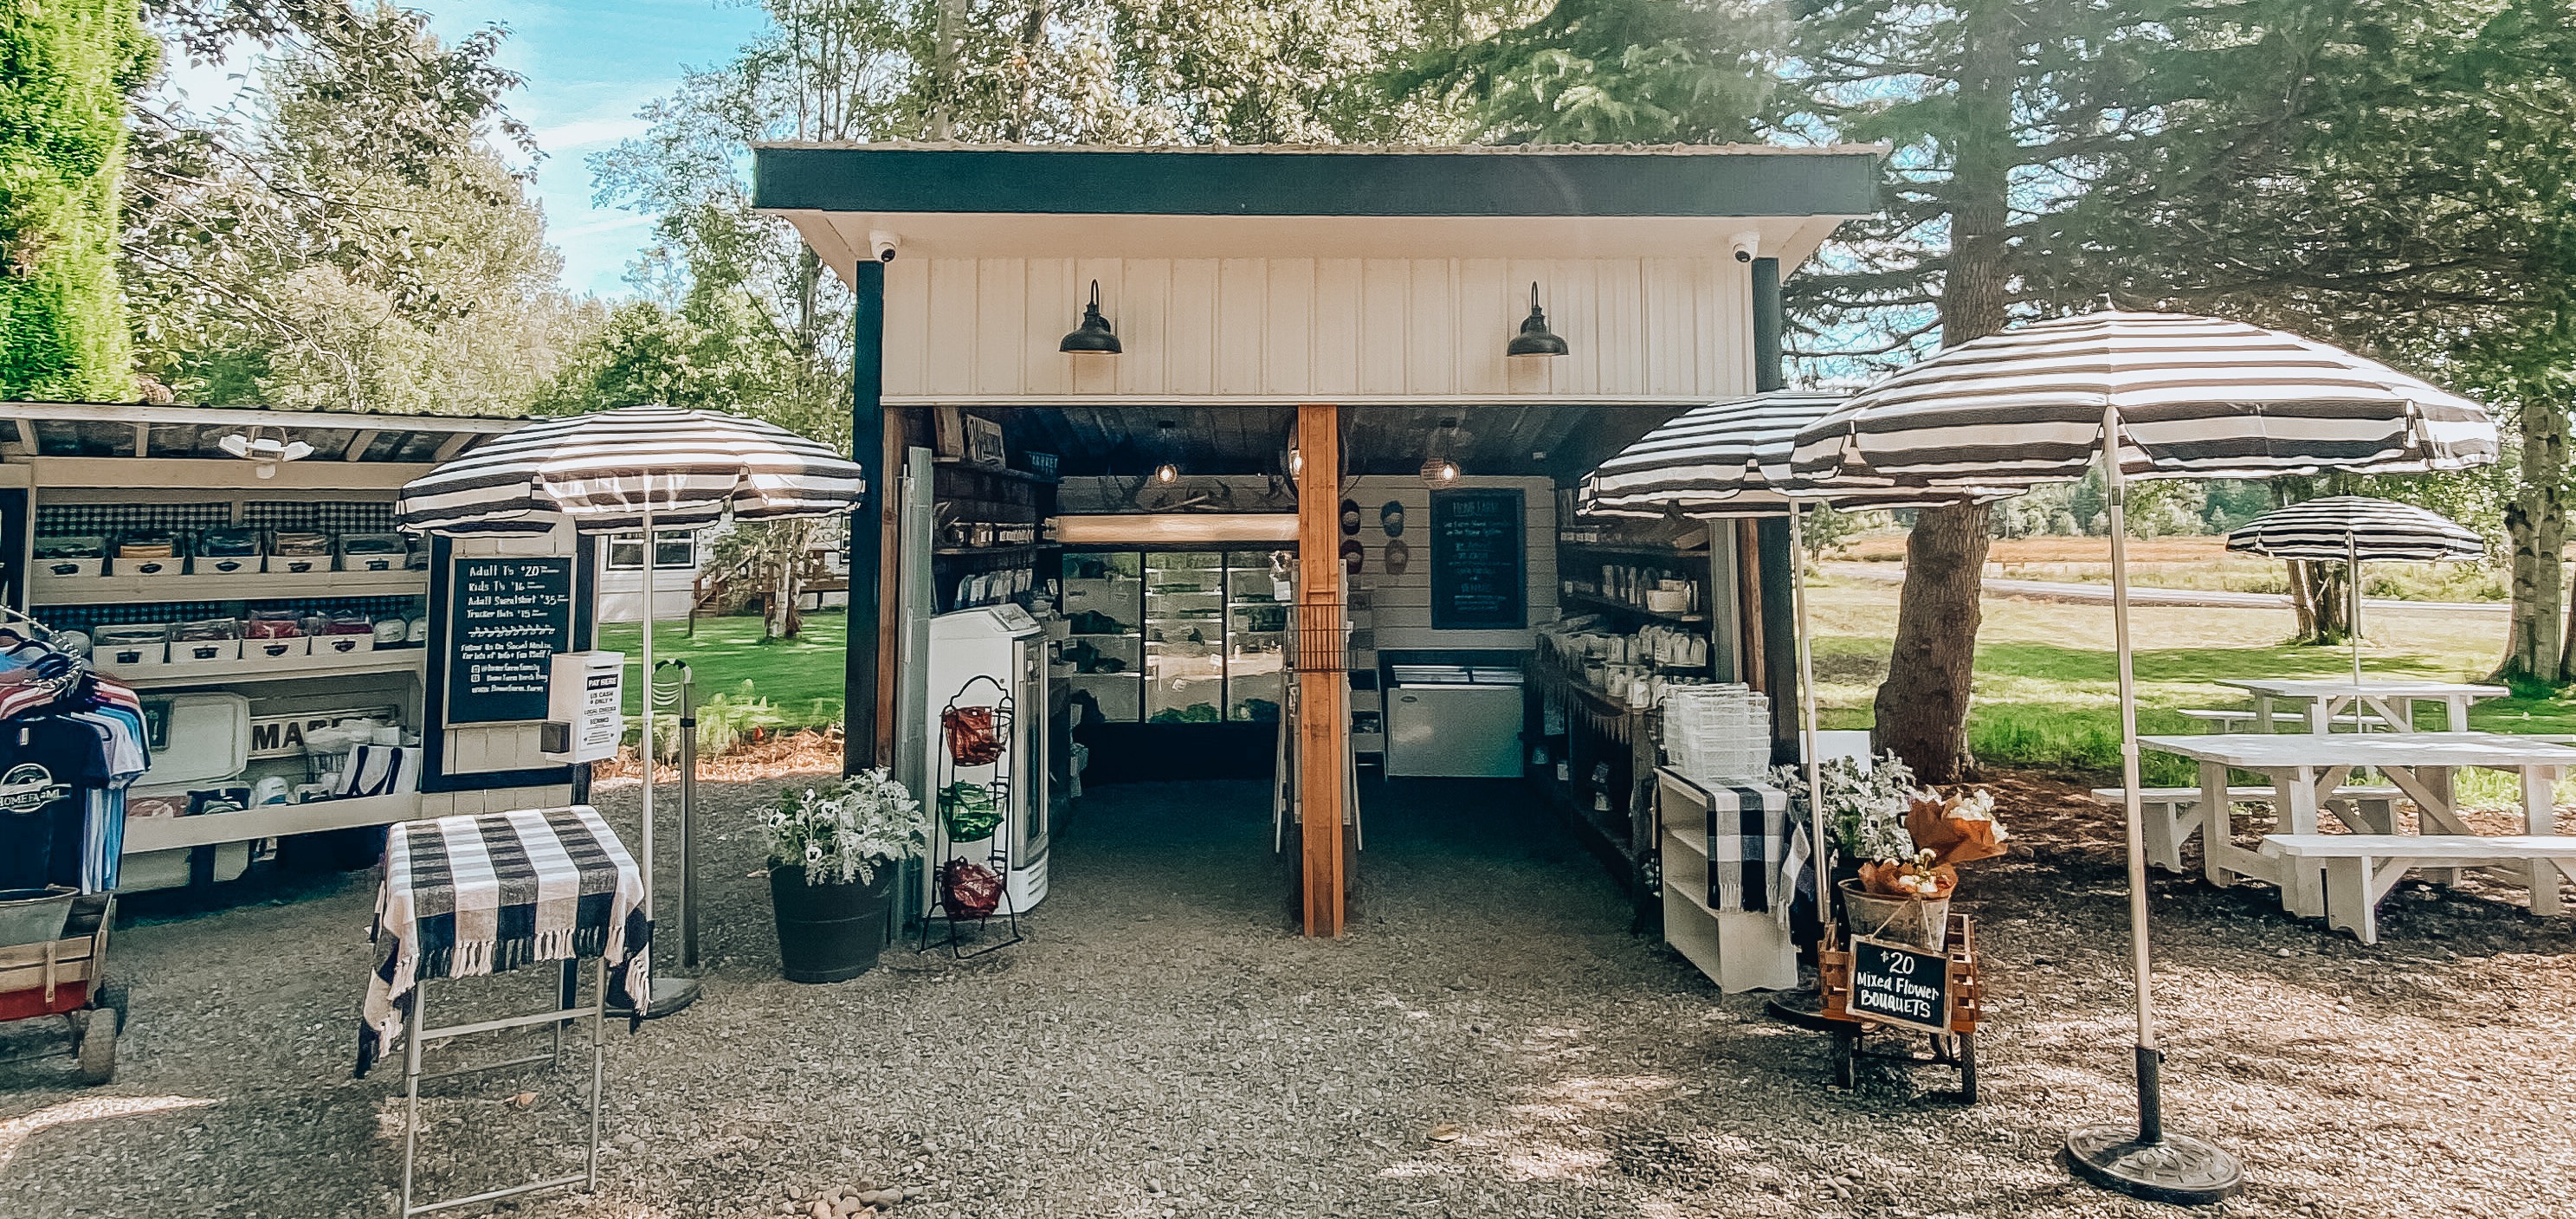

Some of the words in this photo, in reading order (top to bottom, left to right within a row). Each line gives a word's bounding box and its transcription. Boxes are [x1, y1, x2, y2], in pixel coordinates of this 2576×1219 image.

[469, 565, 498, 577] Adult
[468, 581, 489, 591] Kids
[468, 596, 492, 605] Adult
[467, 609, 495, 618] Trucker
[496, 610, 514, 618] Hats
[507, 641, 528, 649] Social
[589, 679, 601, 687] PAY
[1880, 950, 1915, 975] $20
[1856, 971, 1893, 991] Mixed
[1895, 977, 1940, 1001] Flower
